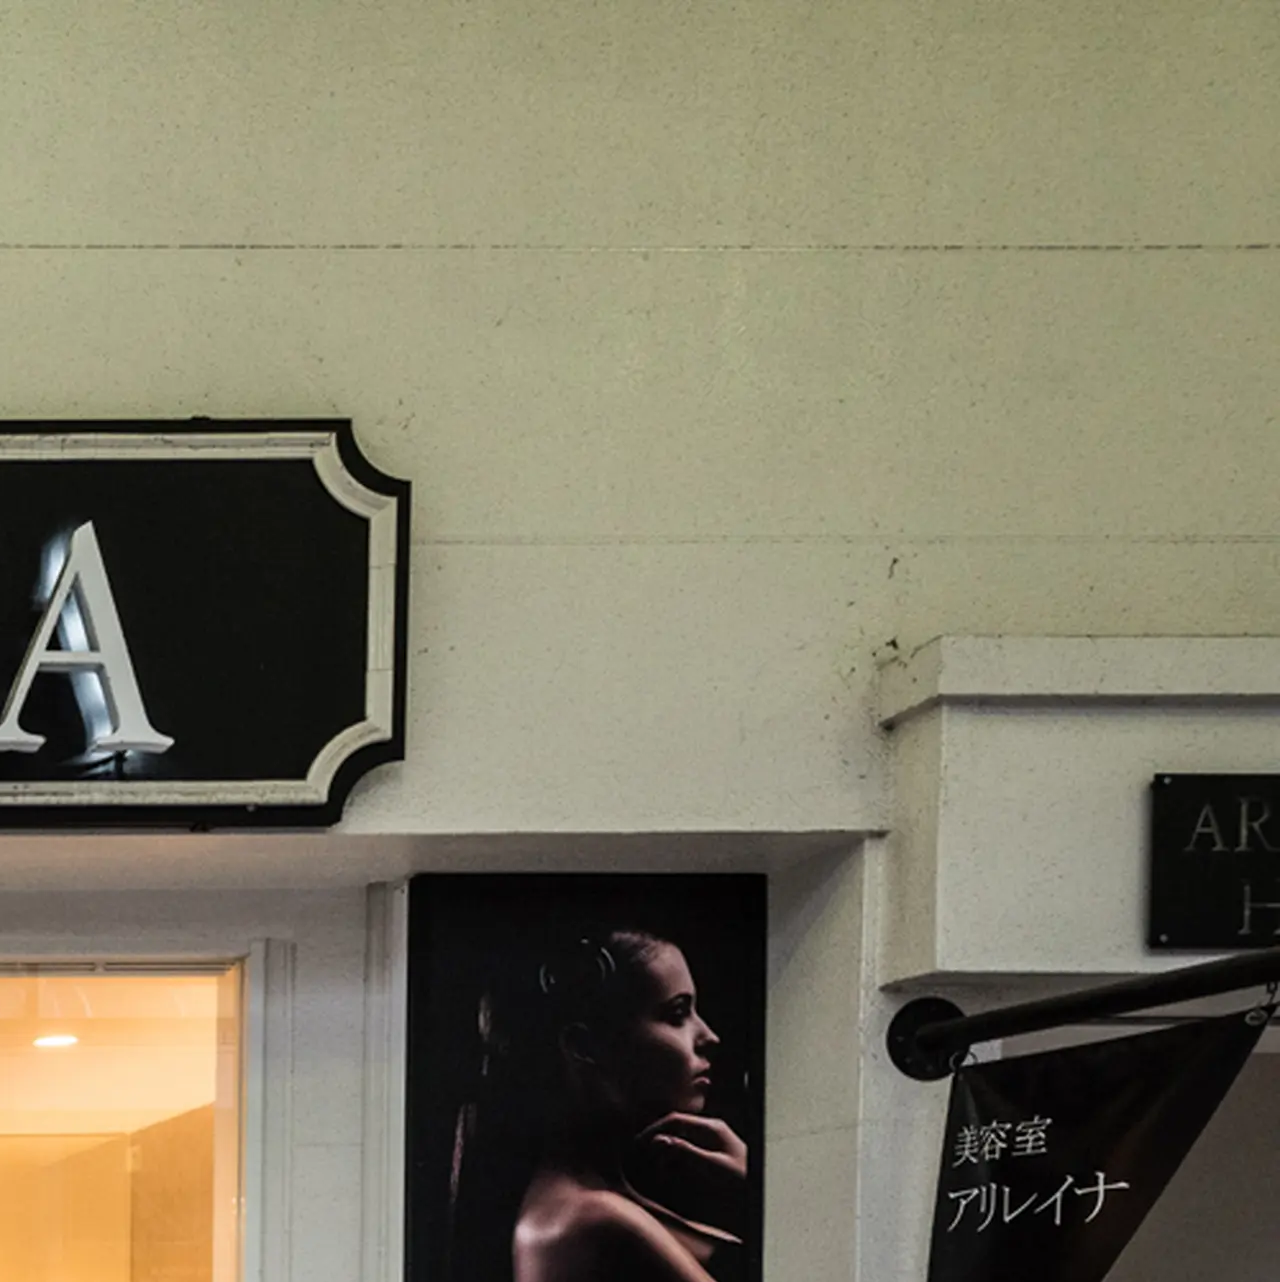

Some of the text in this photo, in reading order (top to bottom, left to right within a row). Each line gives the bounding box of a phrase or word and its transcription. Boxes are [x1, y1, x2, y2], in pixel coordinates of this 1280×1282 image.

[953, 1114, 1053, 1168] 美容室
[947, 1170, 1130, 1233] アリレイナ
